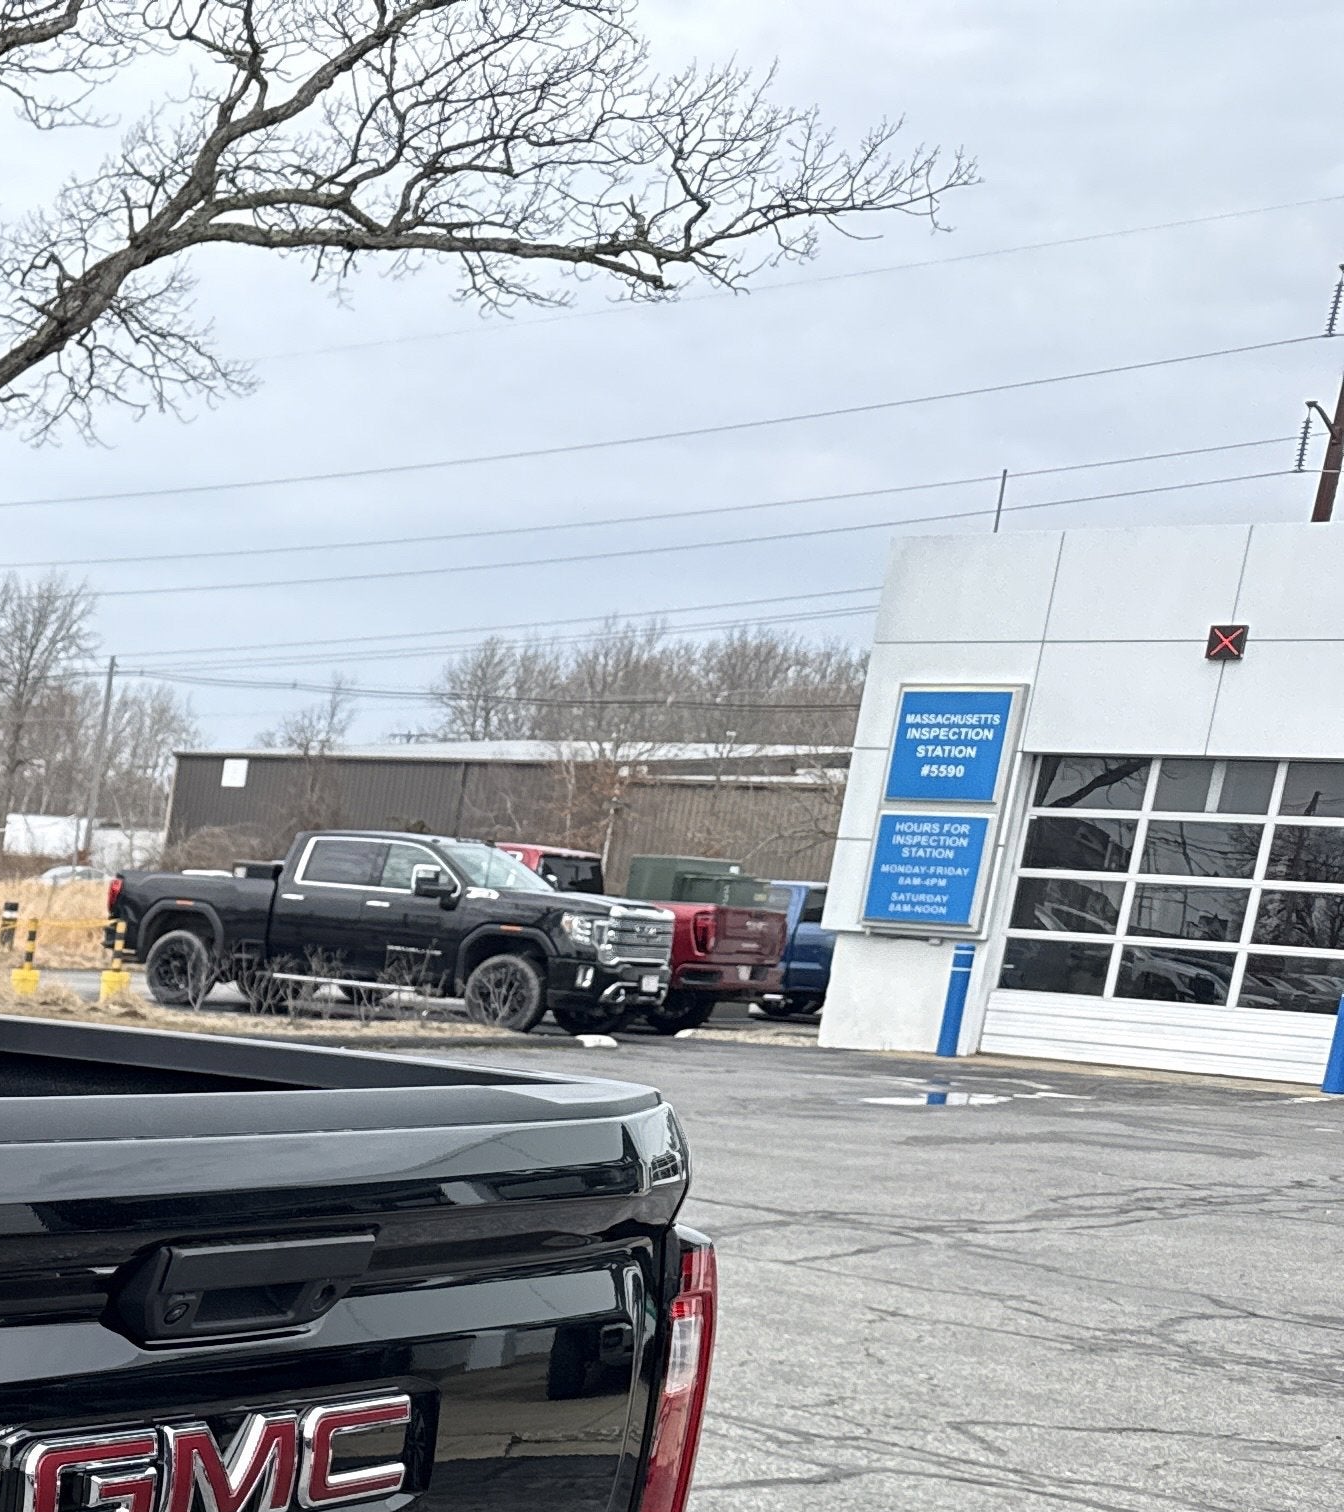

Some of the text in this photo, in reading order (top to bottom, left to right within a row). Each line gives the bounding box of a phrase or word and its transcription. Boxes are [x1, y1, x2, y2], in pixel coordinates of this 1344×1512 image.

[905, 713, 1001, 725] MASSACHUSETTS
[906, 728, 994, 741] INSPECTION
[916, 745, 977, 758] STATION
[920, 764, 965, 778] #5590
[895, 822, 971, 835] HOURS FOR
[892, 835, 969, 847] INSPECTION
[901, 848, 955, 859] STATION
[891, 892, 949, 903] SATURDAY
